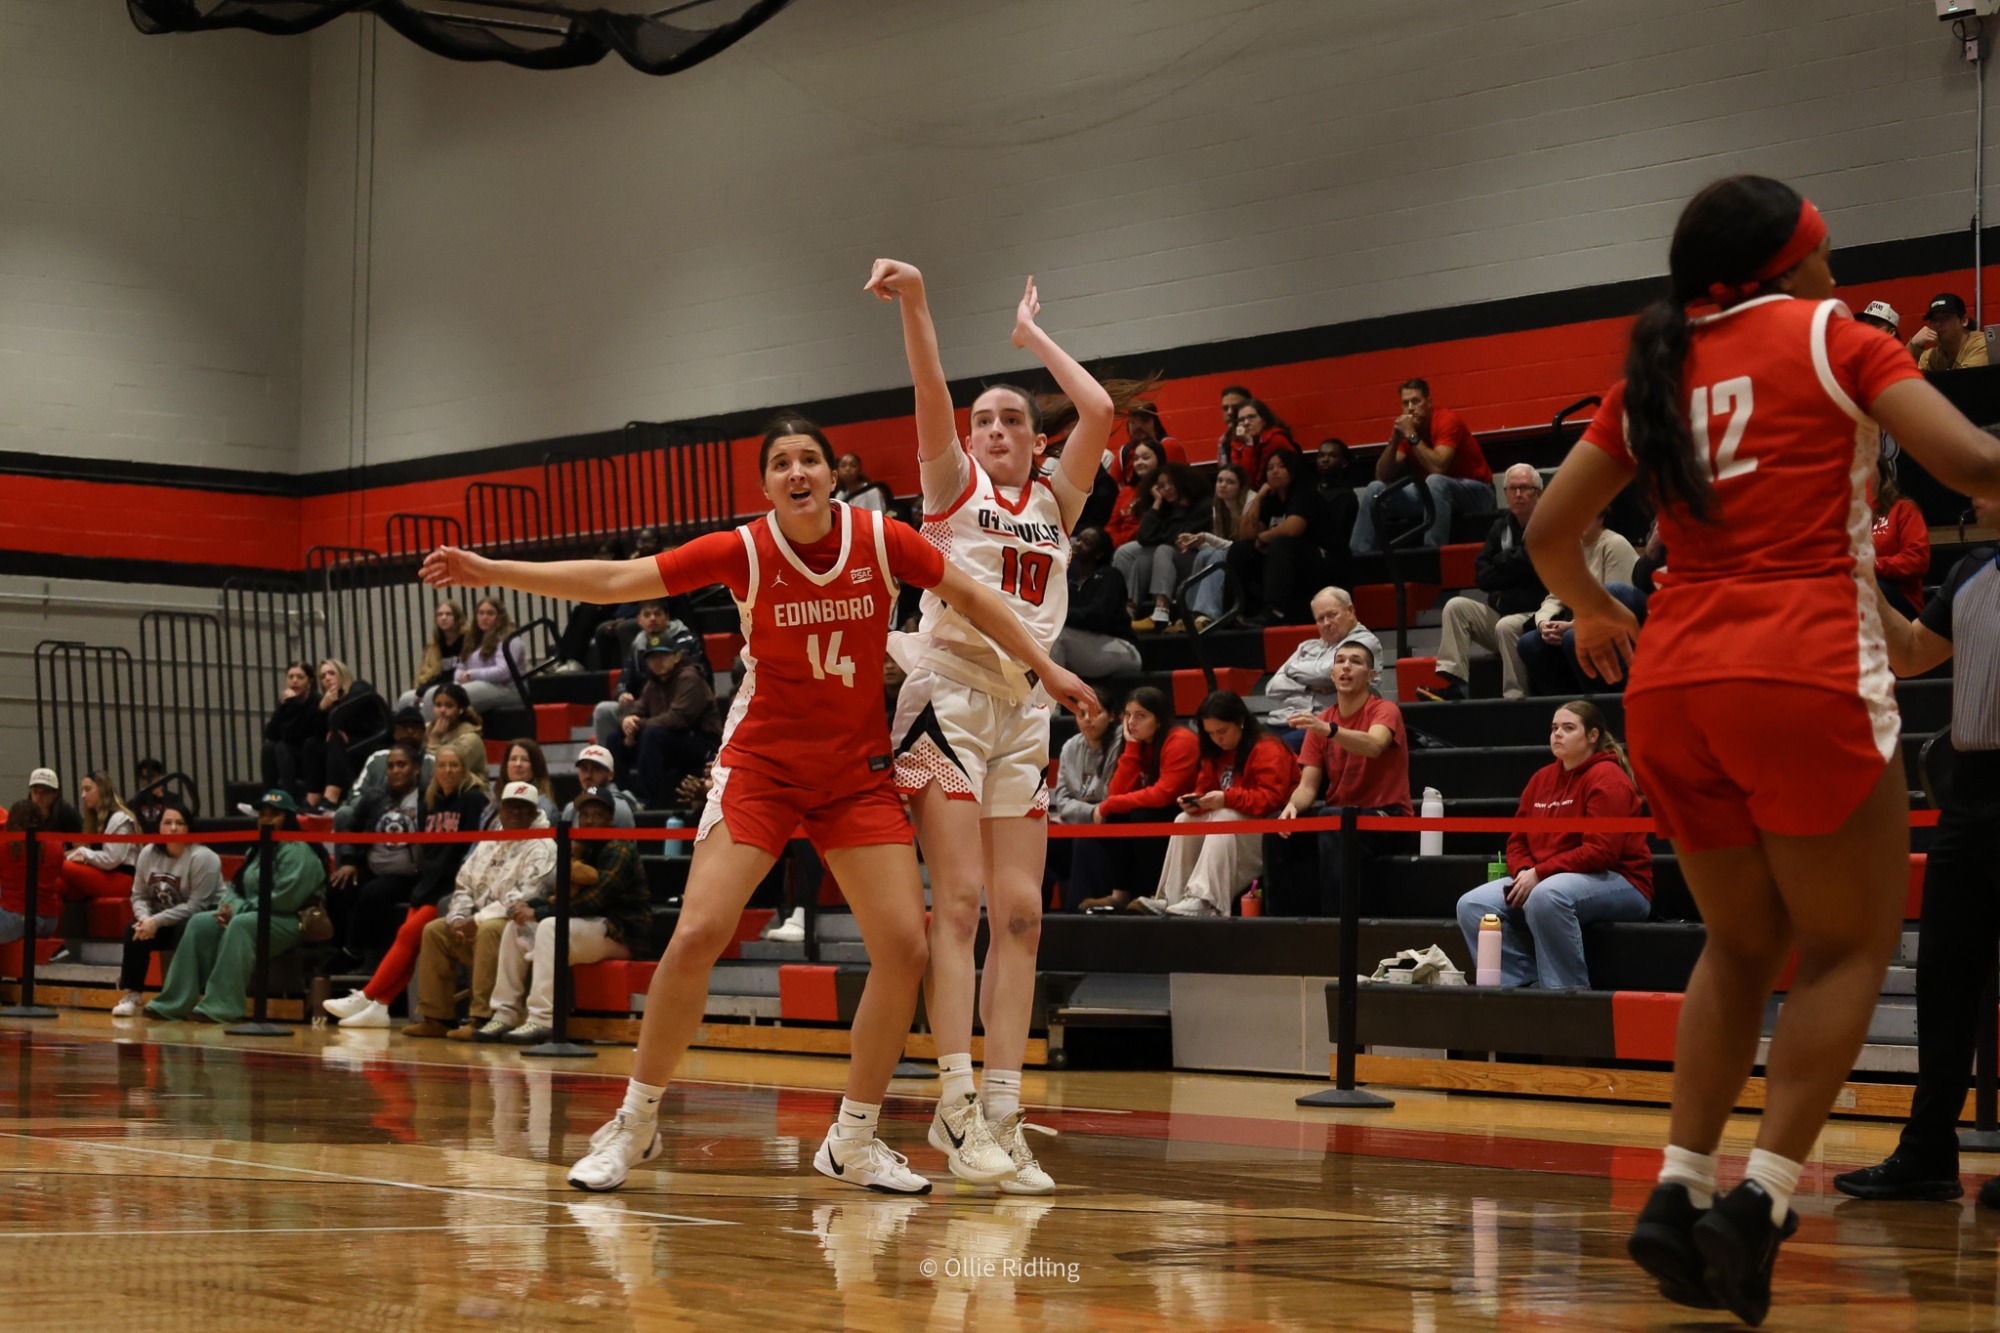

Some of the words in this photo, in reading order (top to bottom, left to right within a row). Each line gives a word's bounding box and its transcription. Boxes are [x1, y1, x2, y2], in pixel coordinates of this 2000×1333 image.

[1690, 375, 1759, 483] 12
[850, 569, 873, 582] PSAC
[1001, 546, 1053, 607] 10
[774, 594, 875, 627] EDINBORO
[806, 630, 856, 688] 14
